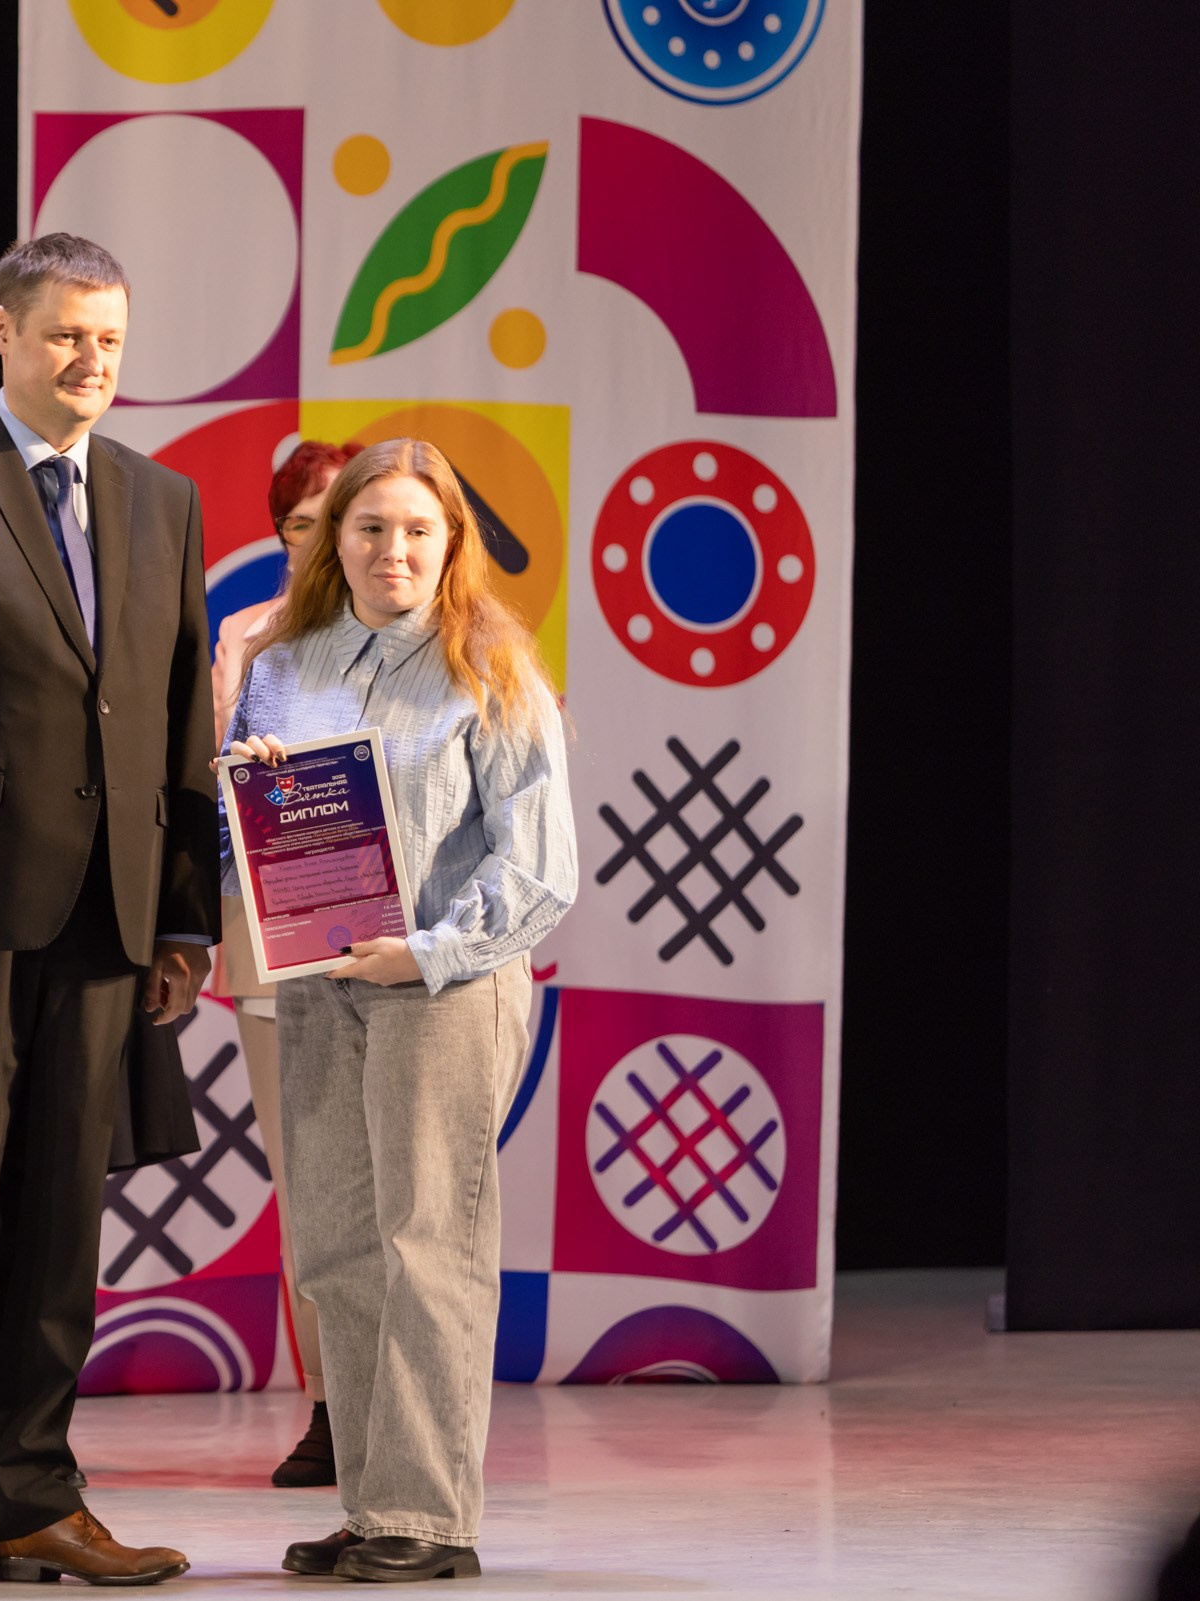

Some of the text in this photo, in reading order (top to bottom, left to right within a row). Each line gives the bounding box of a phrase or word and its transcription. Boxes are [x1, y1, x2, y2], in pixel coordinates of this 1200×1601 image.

[281, 782, 350, 809] Вятка
[302, 779, 348, 791] ТЕАТРАЛЬНАЯ
[280, 800, 349, 824] ДИПЛОМ
